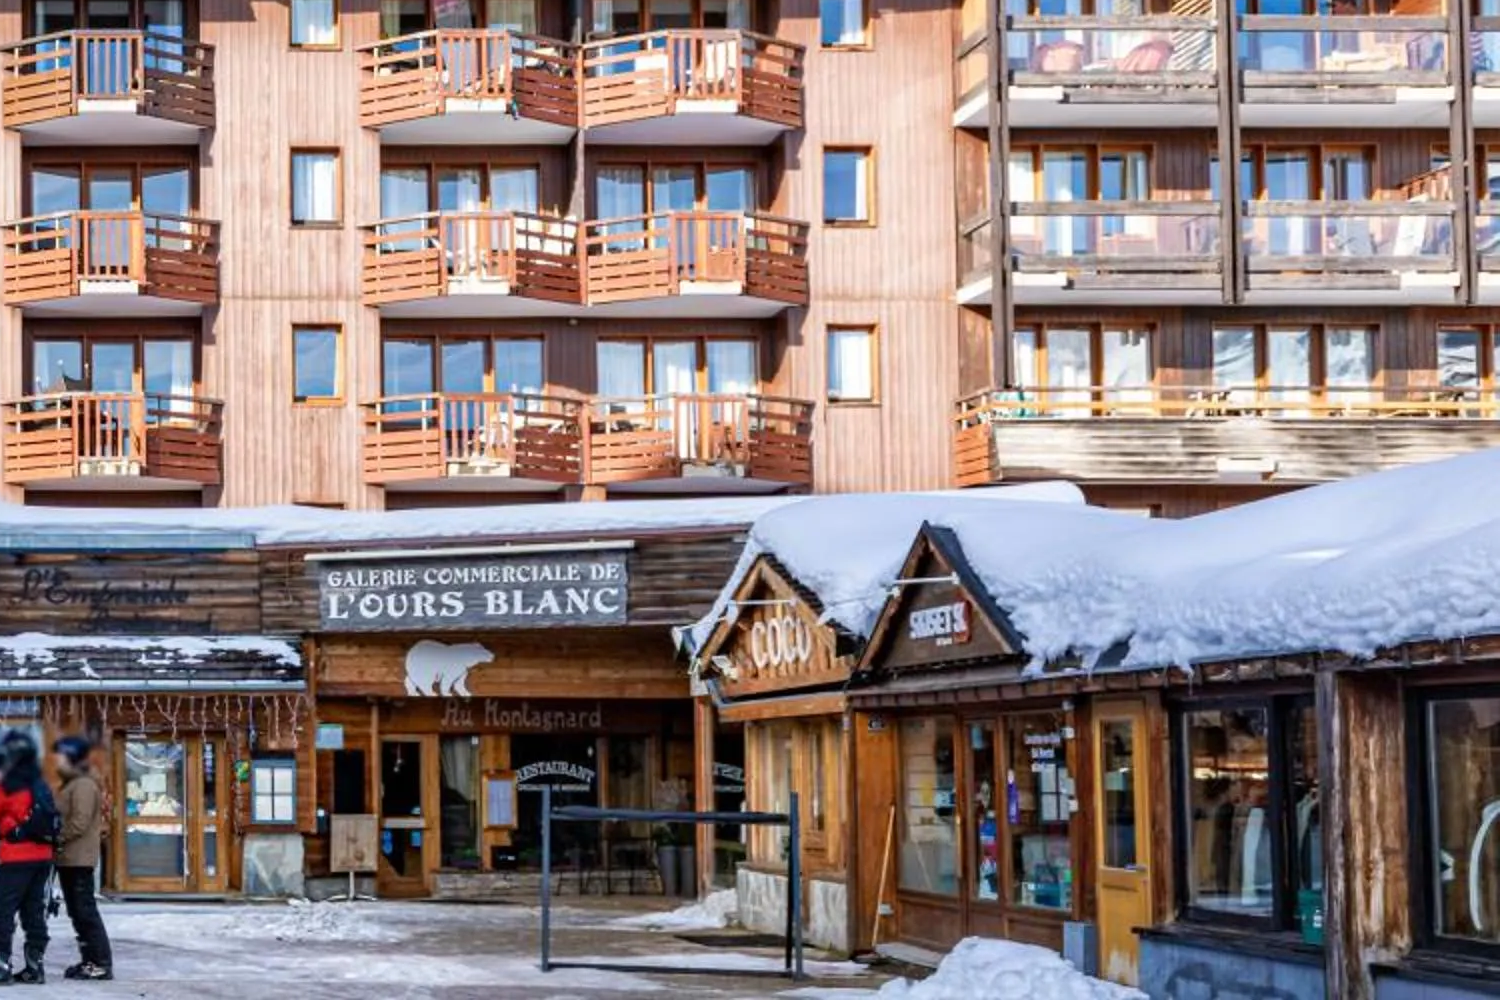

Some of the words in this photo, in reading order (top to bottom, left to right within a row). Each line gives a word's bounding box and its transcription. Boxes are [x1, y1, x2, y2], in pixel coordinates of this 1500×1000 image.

[327, 569, 417, 588] GALERIE
[423, 563, 581, 585] COMMERCIALE
[590, 562, 620, 581] DE
[328, 590, 465, 619] L'OURS
[483, 587, 620, 616] BLANC
[441, 699, 474, 727] Au
[484, 698, 602, 732] Montagnard
[516, 761, 596, 784] RESTAURANT
